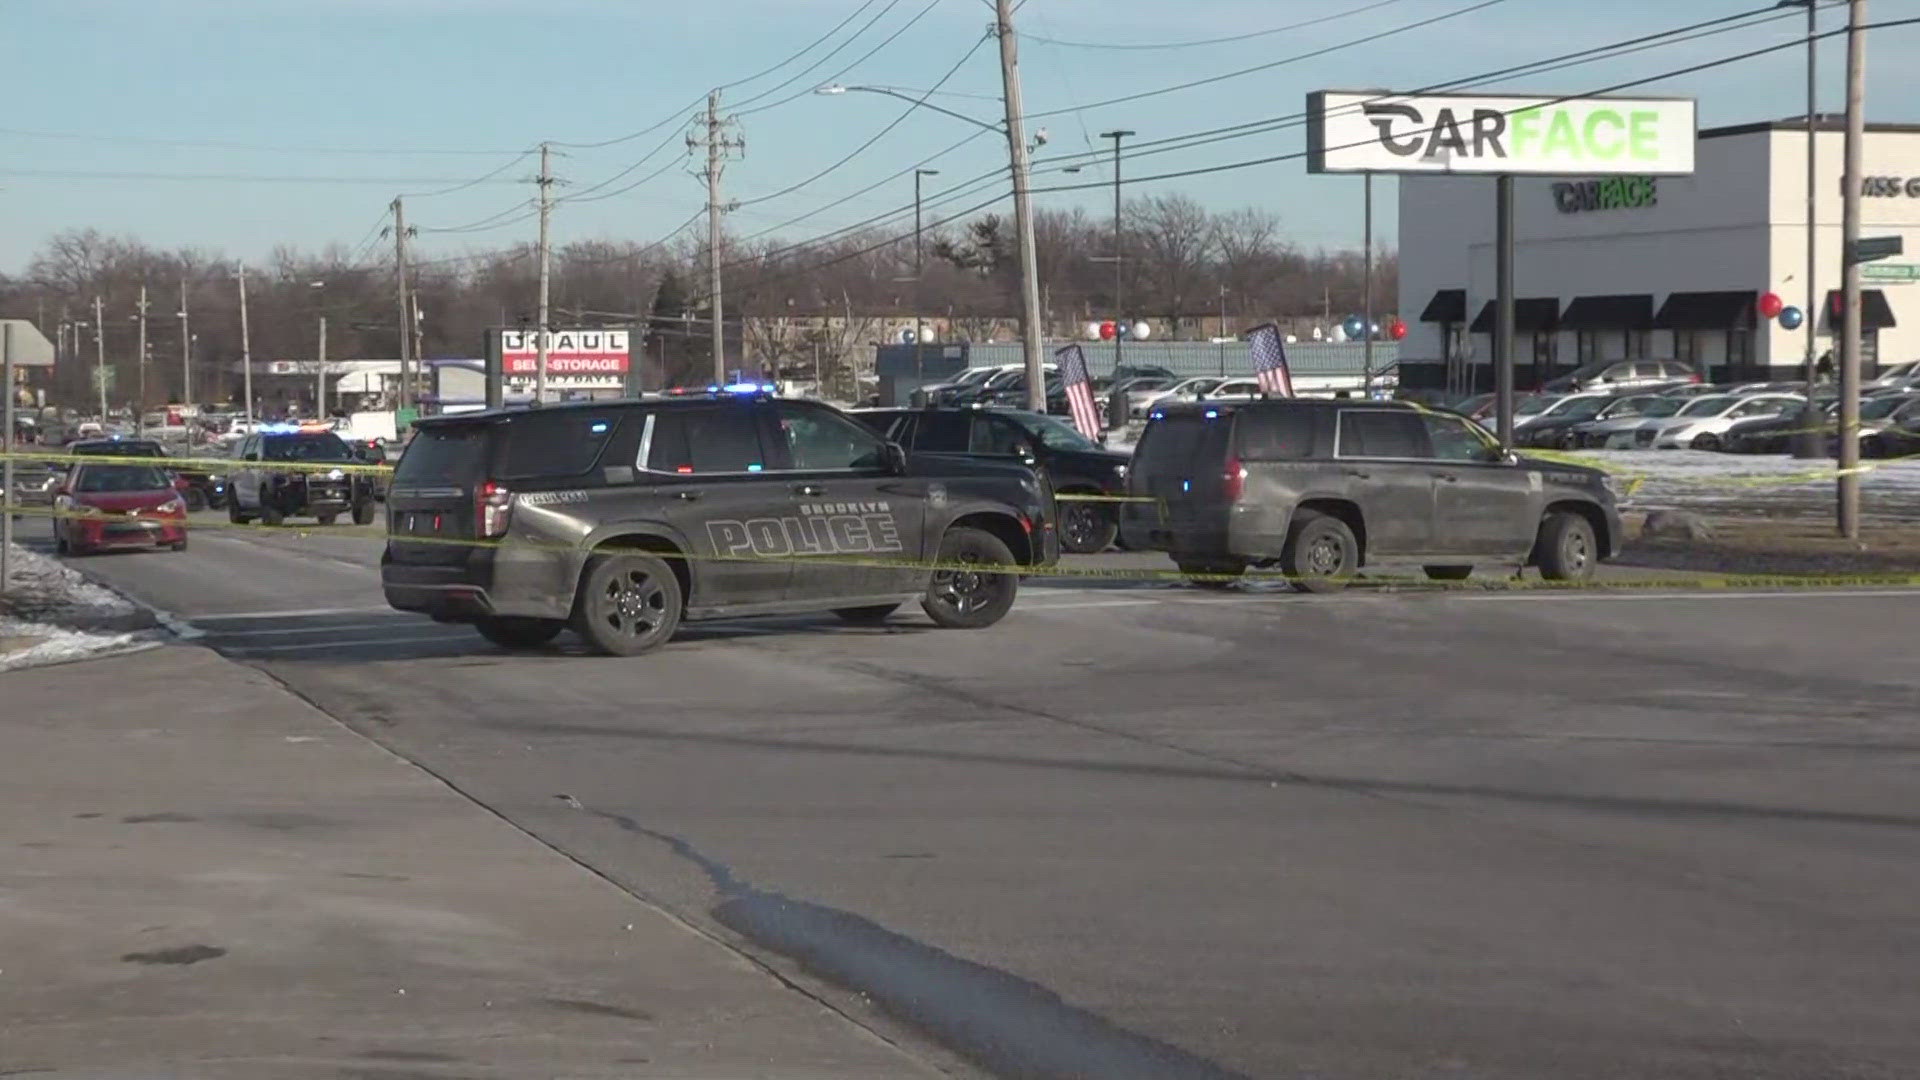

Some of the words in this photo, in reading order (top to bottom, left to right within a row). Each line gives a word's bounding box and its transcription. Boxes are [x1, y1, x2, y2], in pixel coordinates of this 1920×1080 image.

[1362, 101, 1659, 160] CARFACE
[1552, 175, 1658, 214] CARFACE
[801, 502, 890, 516] BROOKLYN
[705, 513, 903, 559] POLICE
